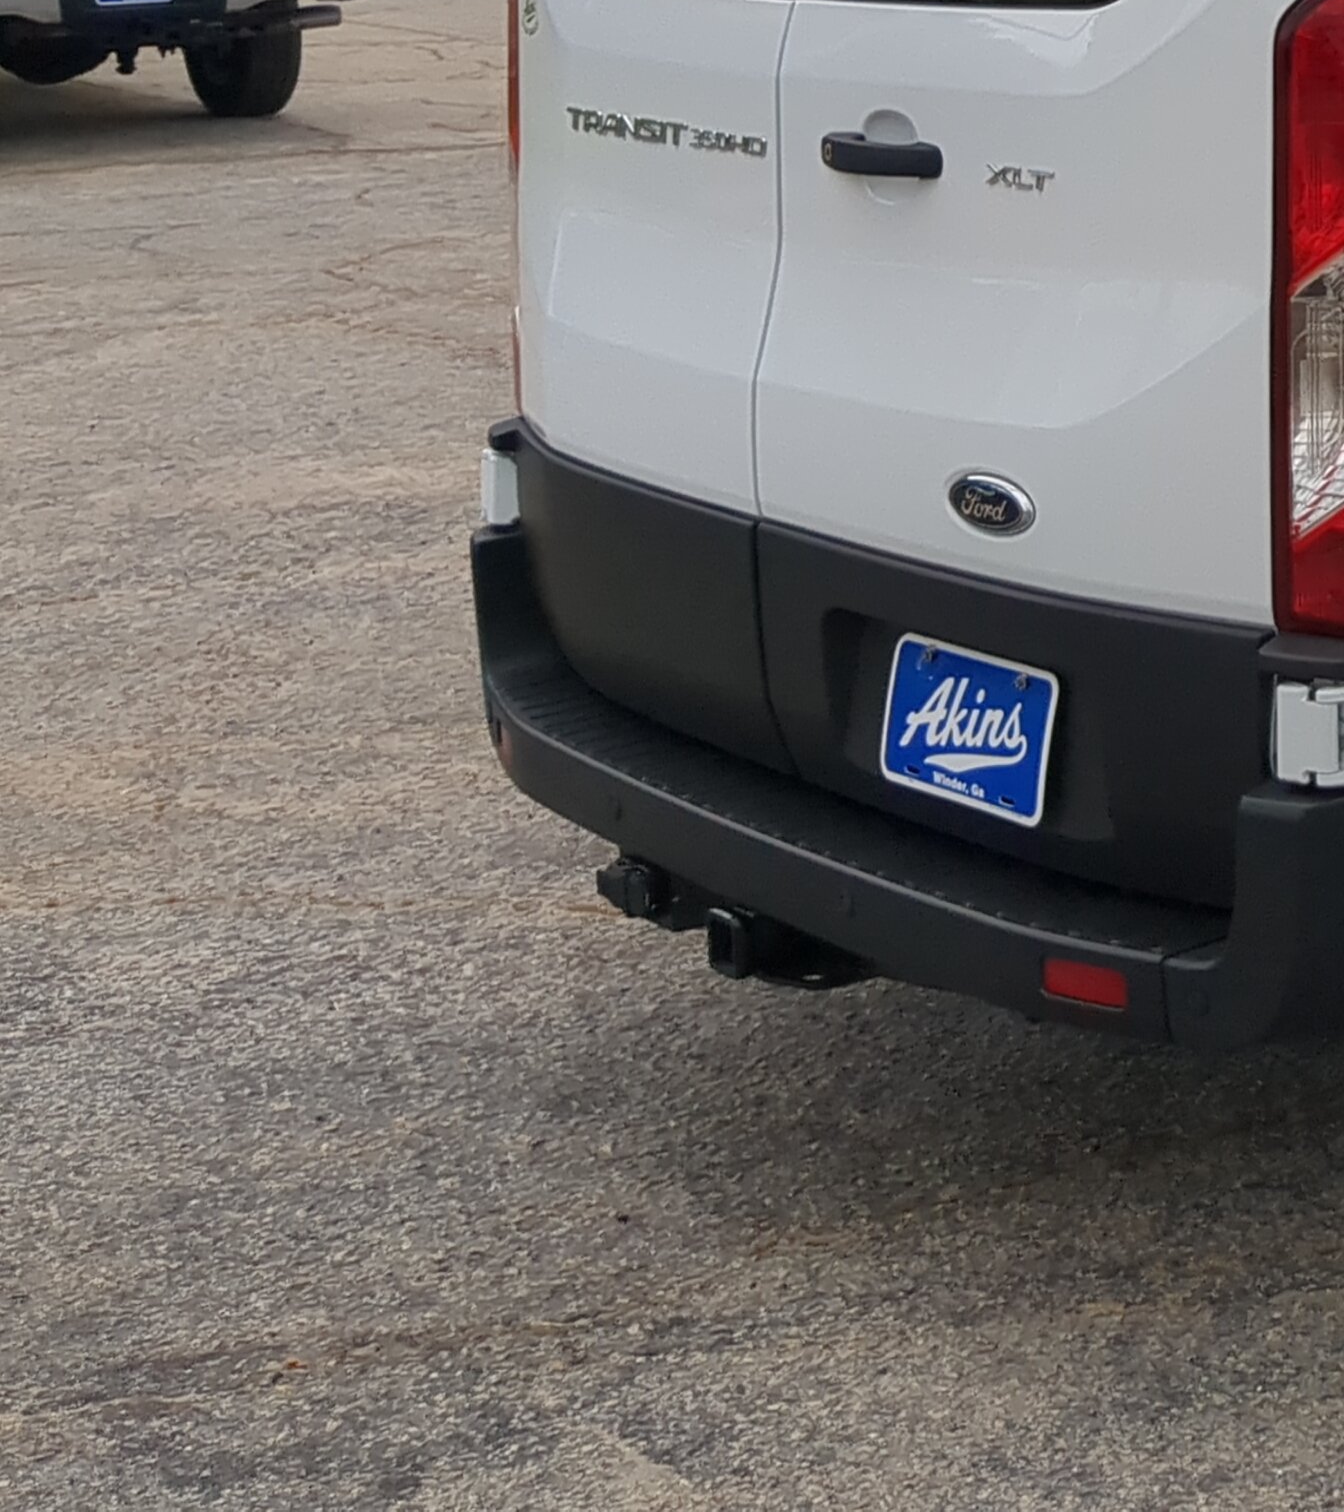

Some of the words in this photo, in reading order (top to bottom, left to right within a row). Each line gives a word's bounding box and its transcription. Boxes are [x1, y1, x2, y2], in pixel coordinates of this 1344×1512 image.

[567, 106, 688, 146] TRANSIT
[689, 128, 768, 157] 350HD
[986, 163, 1055, 192] XLT
[961, 486, 1007, 521] Ford
[899, 677, 1027, 751] Akins
[932, 770, 969, 794] Winder,
